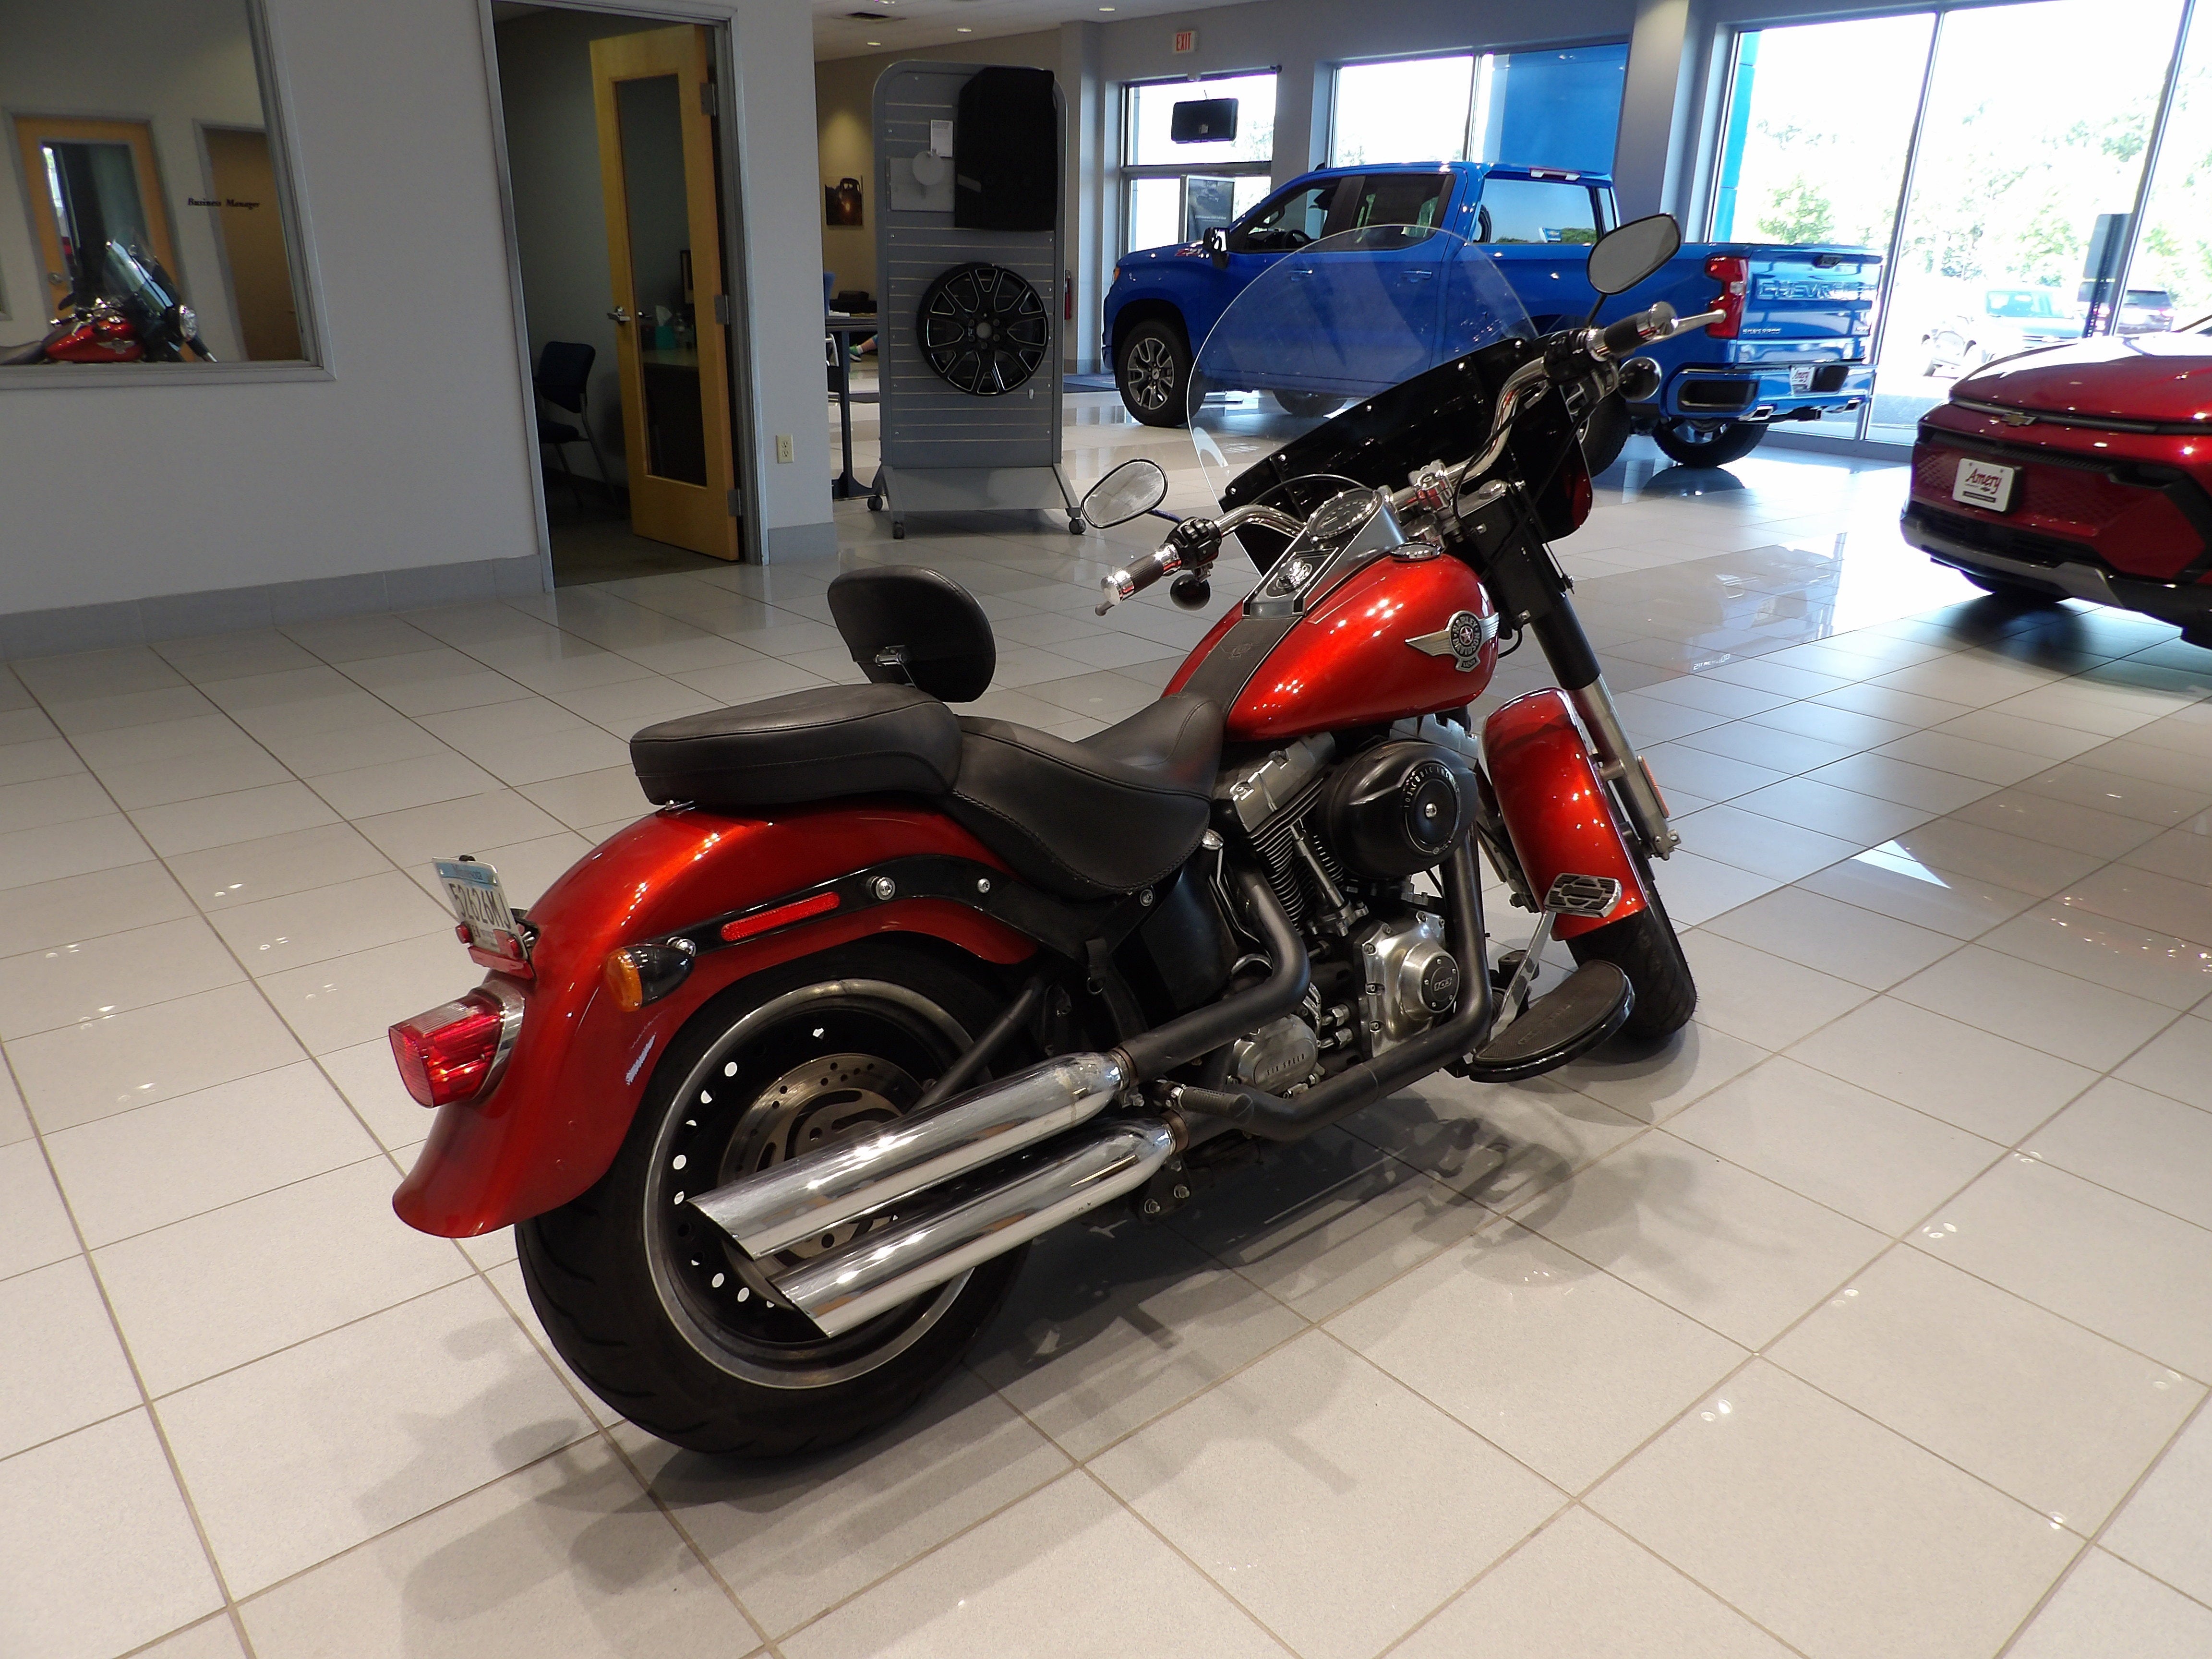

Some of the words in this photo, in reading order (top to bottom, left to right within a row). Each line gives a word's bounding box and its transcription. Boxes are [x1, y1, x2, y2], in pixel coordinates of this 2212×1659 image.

[1176, 32, 1192, 51] EXIT
[188, 197, 222, 207] Business
[226, 198, 260, 210] Manager
[1758, 281, 1874, 300] CHEVR
[1965, 468, 2002, 494] Amery
[1411, 767, 1433, 788] CUBIC
[448, 883, 511, 929] 52626MJ
[1433, 976, 1453, 992] 103
[1267, 1066, 1279, 1076] SIX
[1283, 1053, 1305, 1069] SPEED
